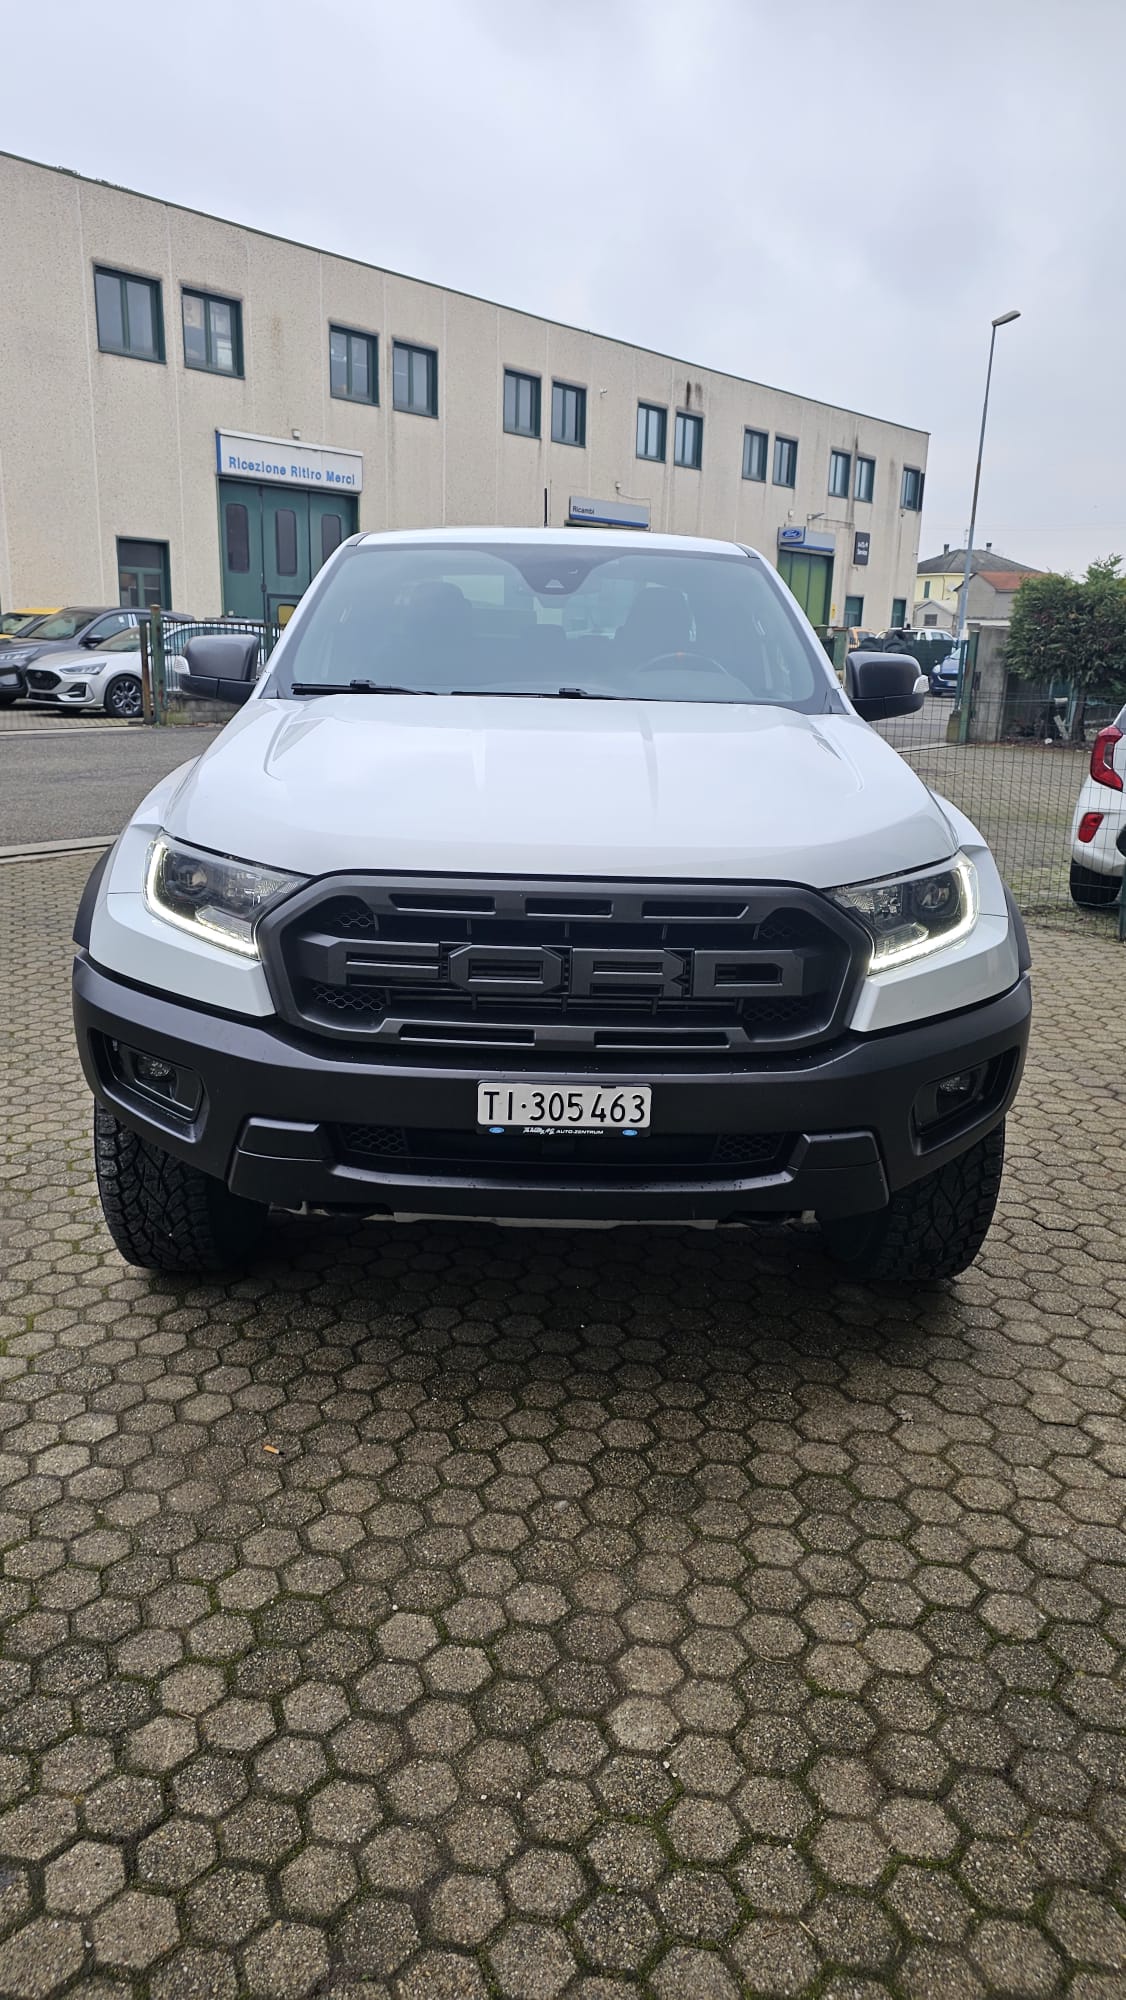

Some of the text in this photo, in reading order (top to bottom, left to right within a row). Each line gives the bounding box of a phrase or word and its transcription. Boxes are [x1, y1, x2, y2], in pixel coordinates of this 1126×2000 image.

[228, 456, 355, 486] Ricezione Ritiro Merci
[572, 505, 595, 515] Ricambi
[327, 940, 800, 998] FORD
